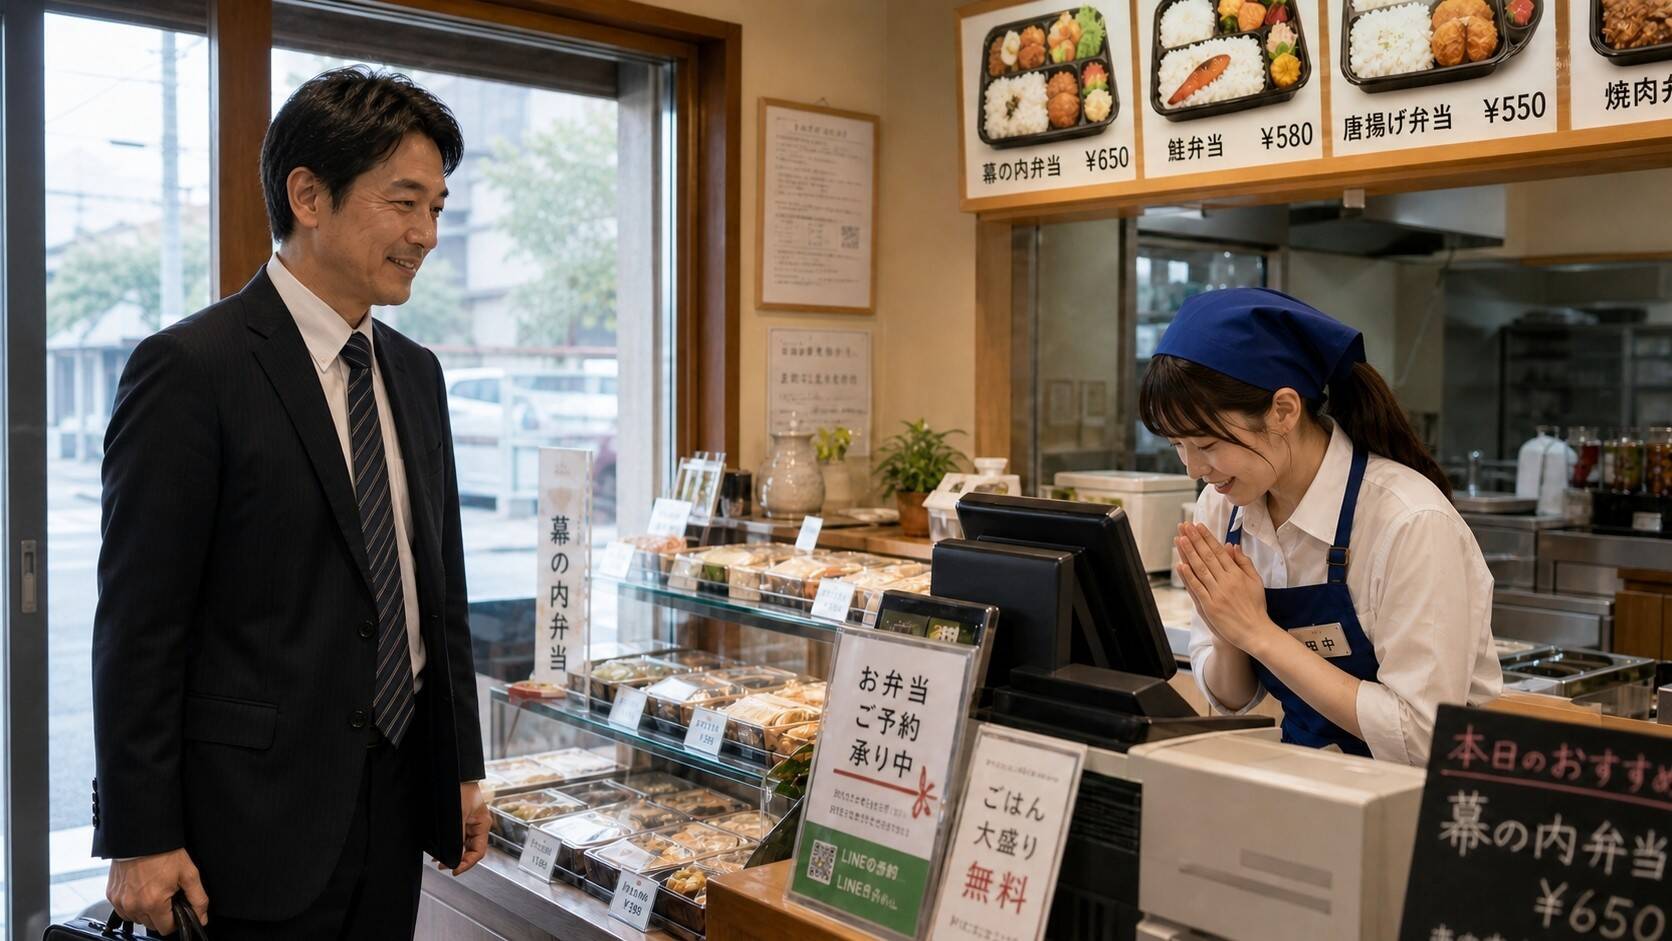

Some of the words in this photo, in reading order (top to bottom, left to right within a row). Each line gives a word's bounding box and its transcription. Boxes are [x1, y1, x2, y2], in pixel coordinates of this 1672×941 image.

[1343, 104, 1452, 141] 唐揚げ弁当
[1484, 91, 1546, 123] ¥550
[1167, 133, 1224, 162] 鮭弁当
[1261, 121, 1313, 149] ¥580
[982, 154, 1061, 185] 幕の内弁当
[1085, 146, 1129, 172] ¥650
[549, 515, 570, 672] 幕の内弁当
[1304, 637, 1335, 652] 田中
[859, 665, 930, 706] お弁当
[855, 704, 921, 742] ご予約
[849, 738, 913, 779] 承り中
[1447, 723, 1672, 798] 本日のおすすめ
[984, 785, 1045, 822] ごはん
[973, 820, 1038, 861] 大盛り
[1438, 790, 1669, 882] 幕の内弁当
[961, 860, 1028, 916] 無料
[1533, 877, 1666, 941] ¥650
